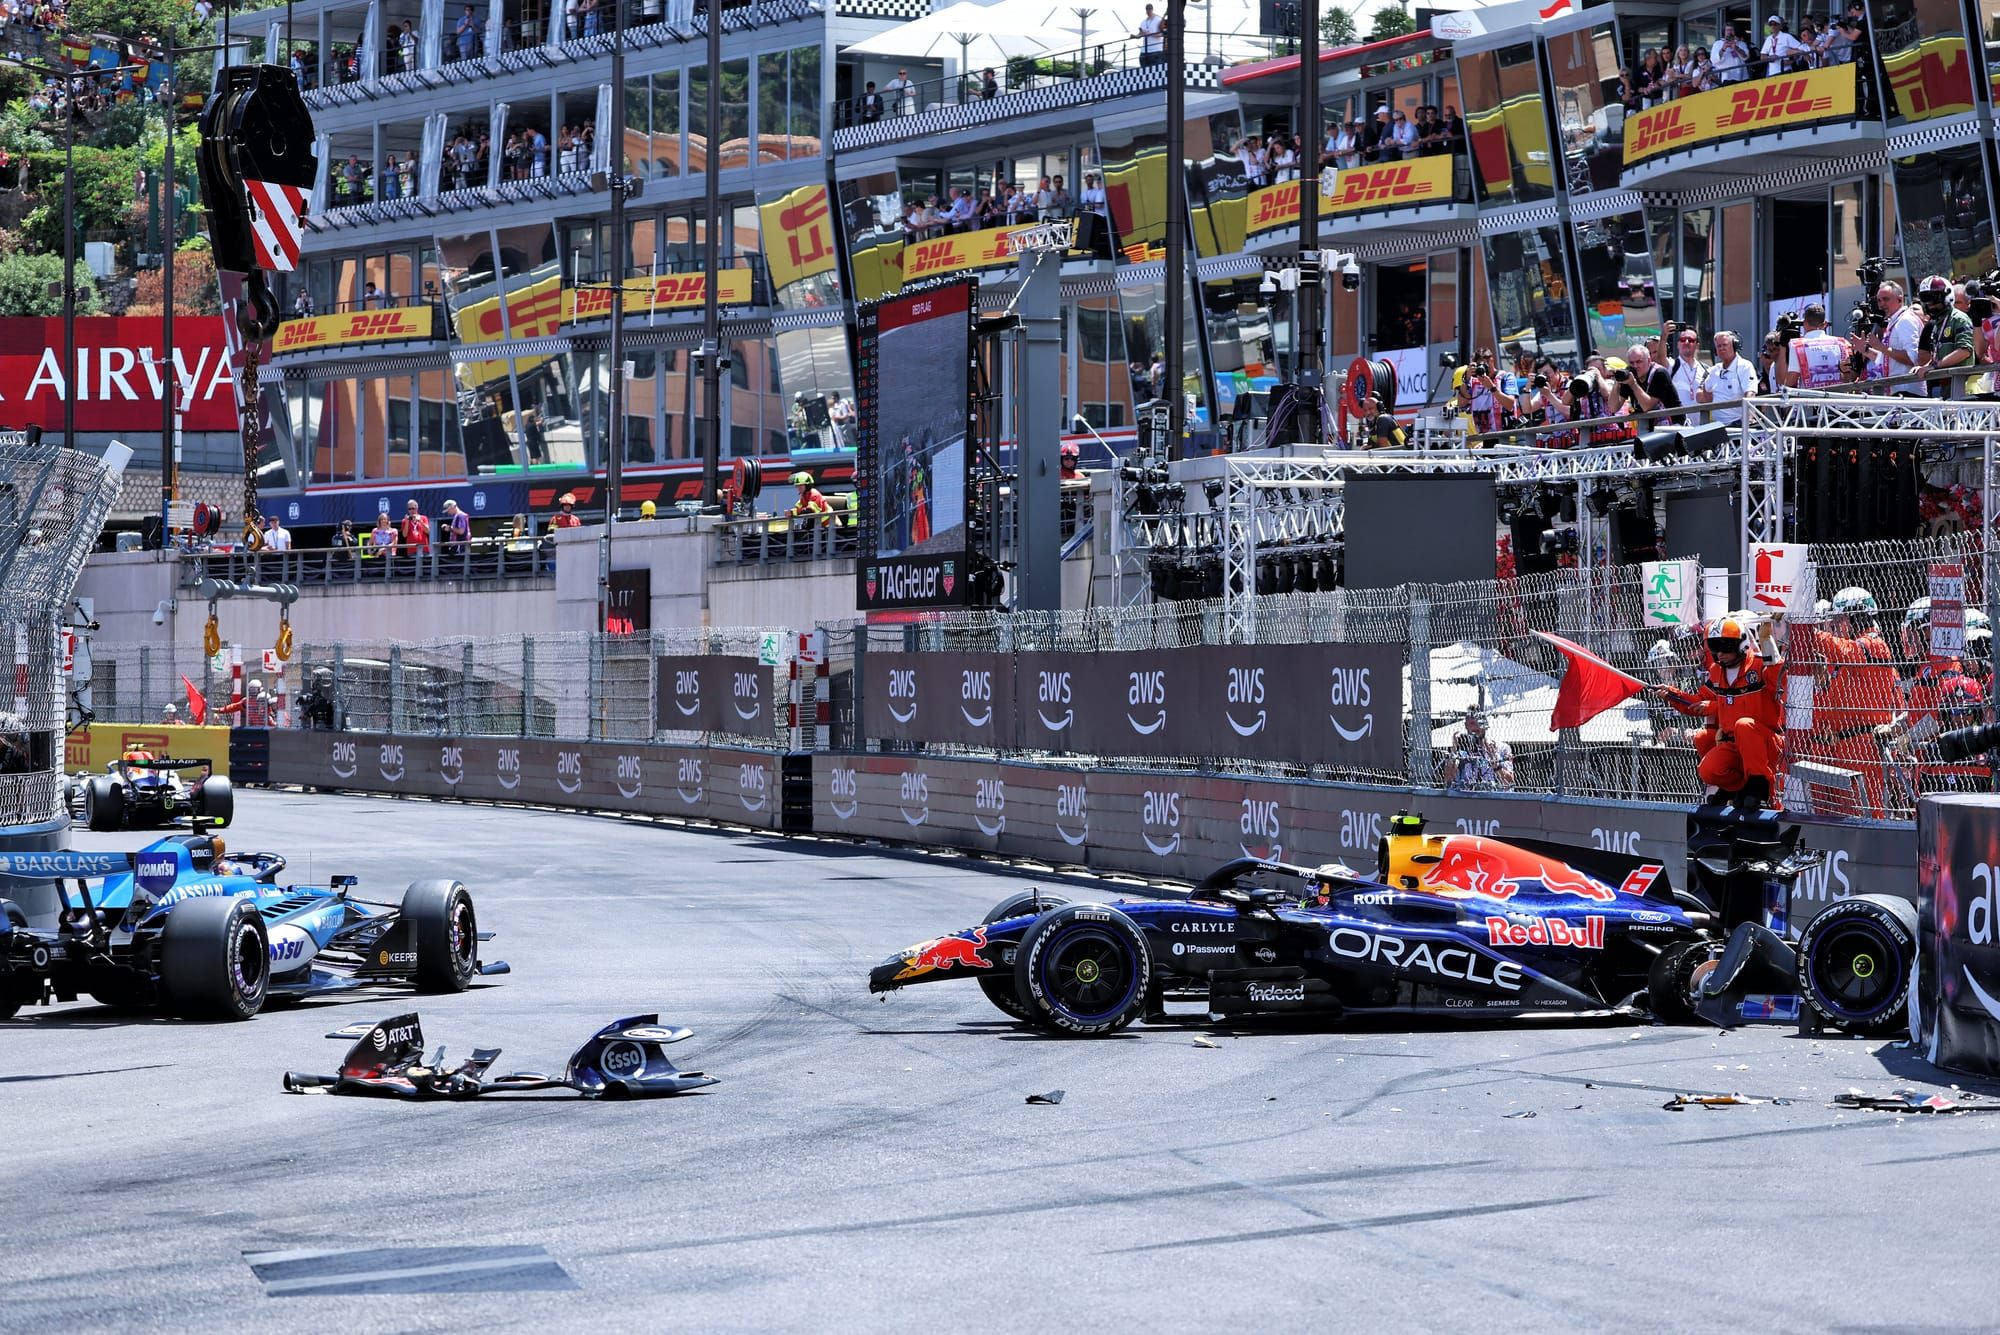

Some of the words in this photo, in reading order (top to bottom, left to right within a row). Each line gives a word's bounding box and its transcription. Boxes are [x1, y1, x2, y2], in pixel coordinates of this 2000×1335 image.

[1730, 78, 1813, 125] DHL
[1637, 106, 1684, 150] DHL
[1343, 166, 1416, 203] DHL
[914, 241, 958, 272] DHL
[656, 277, 707, 303] DH
[283, 321, 318, 345] DHL
[350, 312, 405, 337] DHL
[1648, 601, 1682, 609] EXIT
[676, 670, 699, 694] aws
[734, 672, 758, 698] aws
[889, 669, 915, 698] aws
[962, 670, 990, 701] aws
[1039, 671, 1072, 703] aws
[1129, 670, 1165, 705] aws
[1227, 667, 1265, 704] aws
[1331, 667, 1371, 707] aws
[333, 742, 356, 762] aws
[381, 744, 403, 764] aws
[442, 747, 462, 767] aws
[498, 749, 519, 771] aws
[558, 752, 581, 774] aws
[618, 756, 641, 779] aws
[679, 758, 701, 783] aws
[741, 764, 764, 790] aws
[832, 768, 856, 796] aws
[901, 771, 928, 801] aws
[976, 778, 1004, 810] aws
[1057, 784, 1086, 817] aws
[1143, 790, 1180, 827] aws
[1241, 799, 1279, 838] aws
[1340, 809, 1382, 852] aws
[15, 855, 112, 872] BARCLAYS
[138, 859, 175, 877] KOMATSU
[1299, 870, 1316, 879] VISA
[1620, 864, 1664, 896] 6
[1353, 894, 1395, 905] ROKT
[1075, 911, 1110, 921] PIRELLI
[1171, 923, 1236, 933] CARLYLE
[1638, 912, 1664, 922] Ford
[1484, 917, 1547, 946] Red
[1546, 915, 1605, 949] Bull
[1880, 913, 1908, 945] PIRELLI
[389, 952, 417, 963] KEEPER
[1186, 945, 1236, 954] 1Password
[1330, 927, 1523, 990] ORACLE
[1246, 983, 1304, 1001] indeed
[1486, 999, 1520, 1007] SIEMENS
[388, 1024, 414, 1045] AT&T
[1055, 1017, 1110, 1033] ZERO
[607, 1050, 640, 1070] Esso
